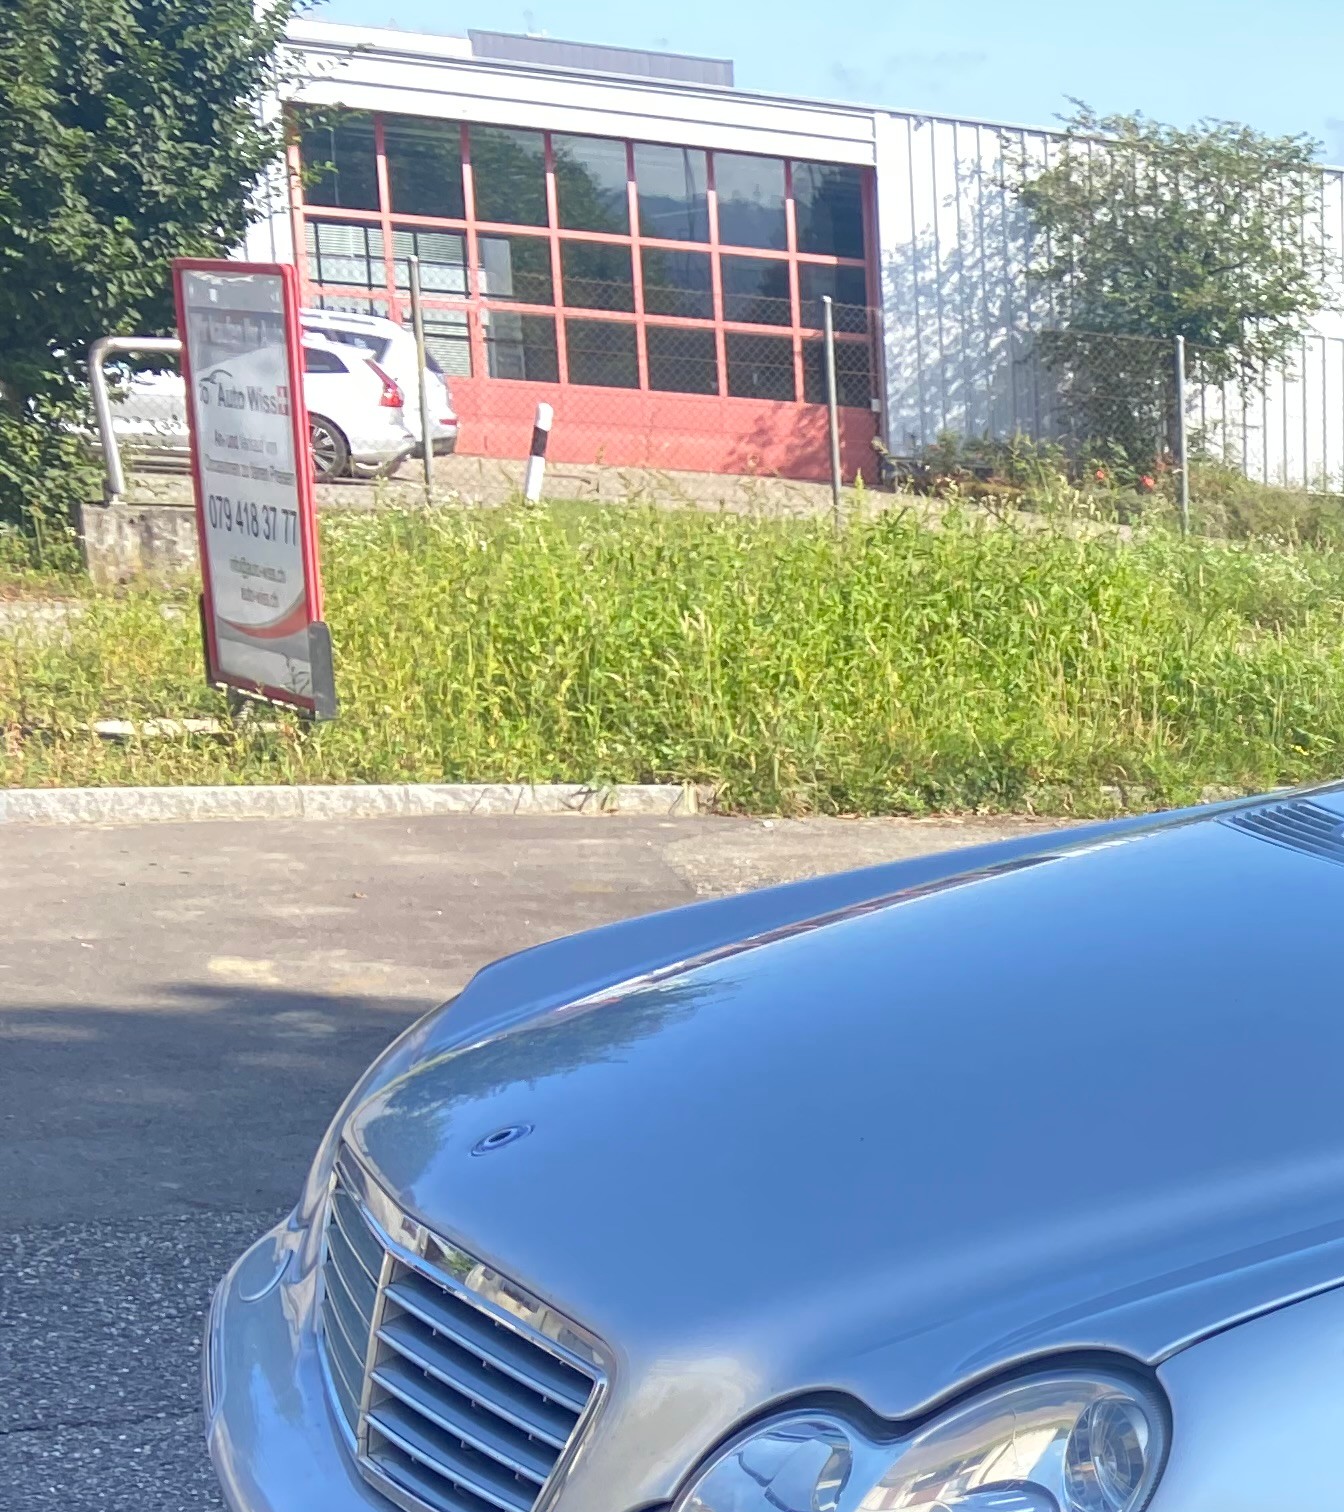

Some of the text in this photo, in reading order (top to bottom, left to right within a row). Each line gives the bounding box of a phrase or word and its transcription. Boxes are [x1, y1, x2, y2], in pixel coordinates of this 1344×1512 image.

[217, 382, 245, 410] Auto
[246, 385, 278, 415] Wiss
[208, 494, 297, 545] 079 418 37 77
